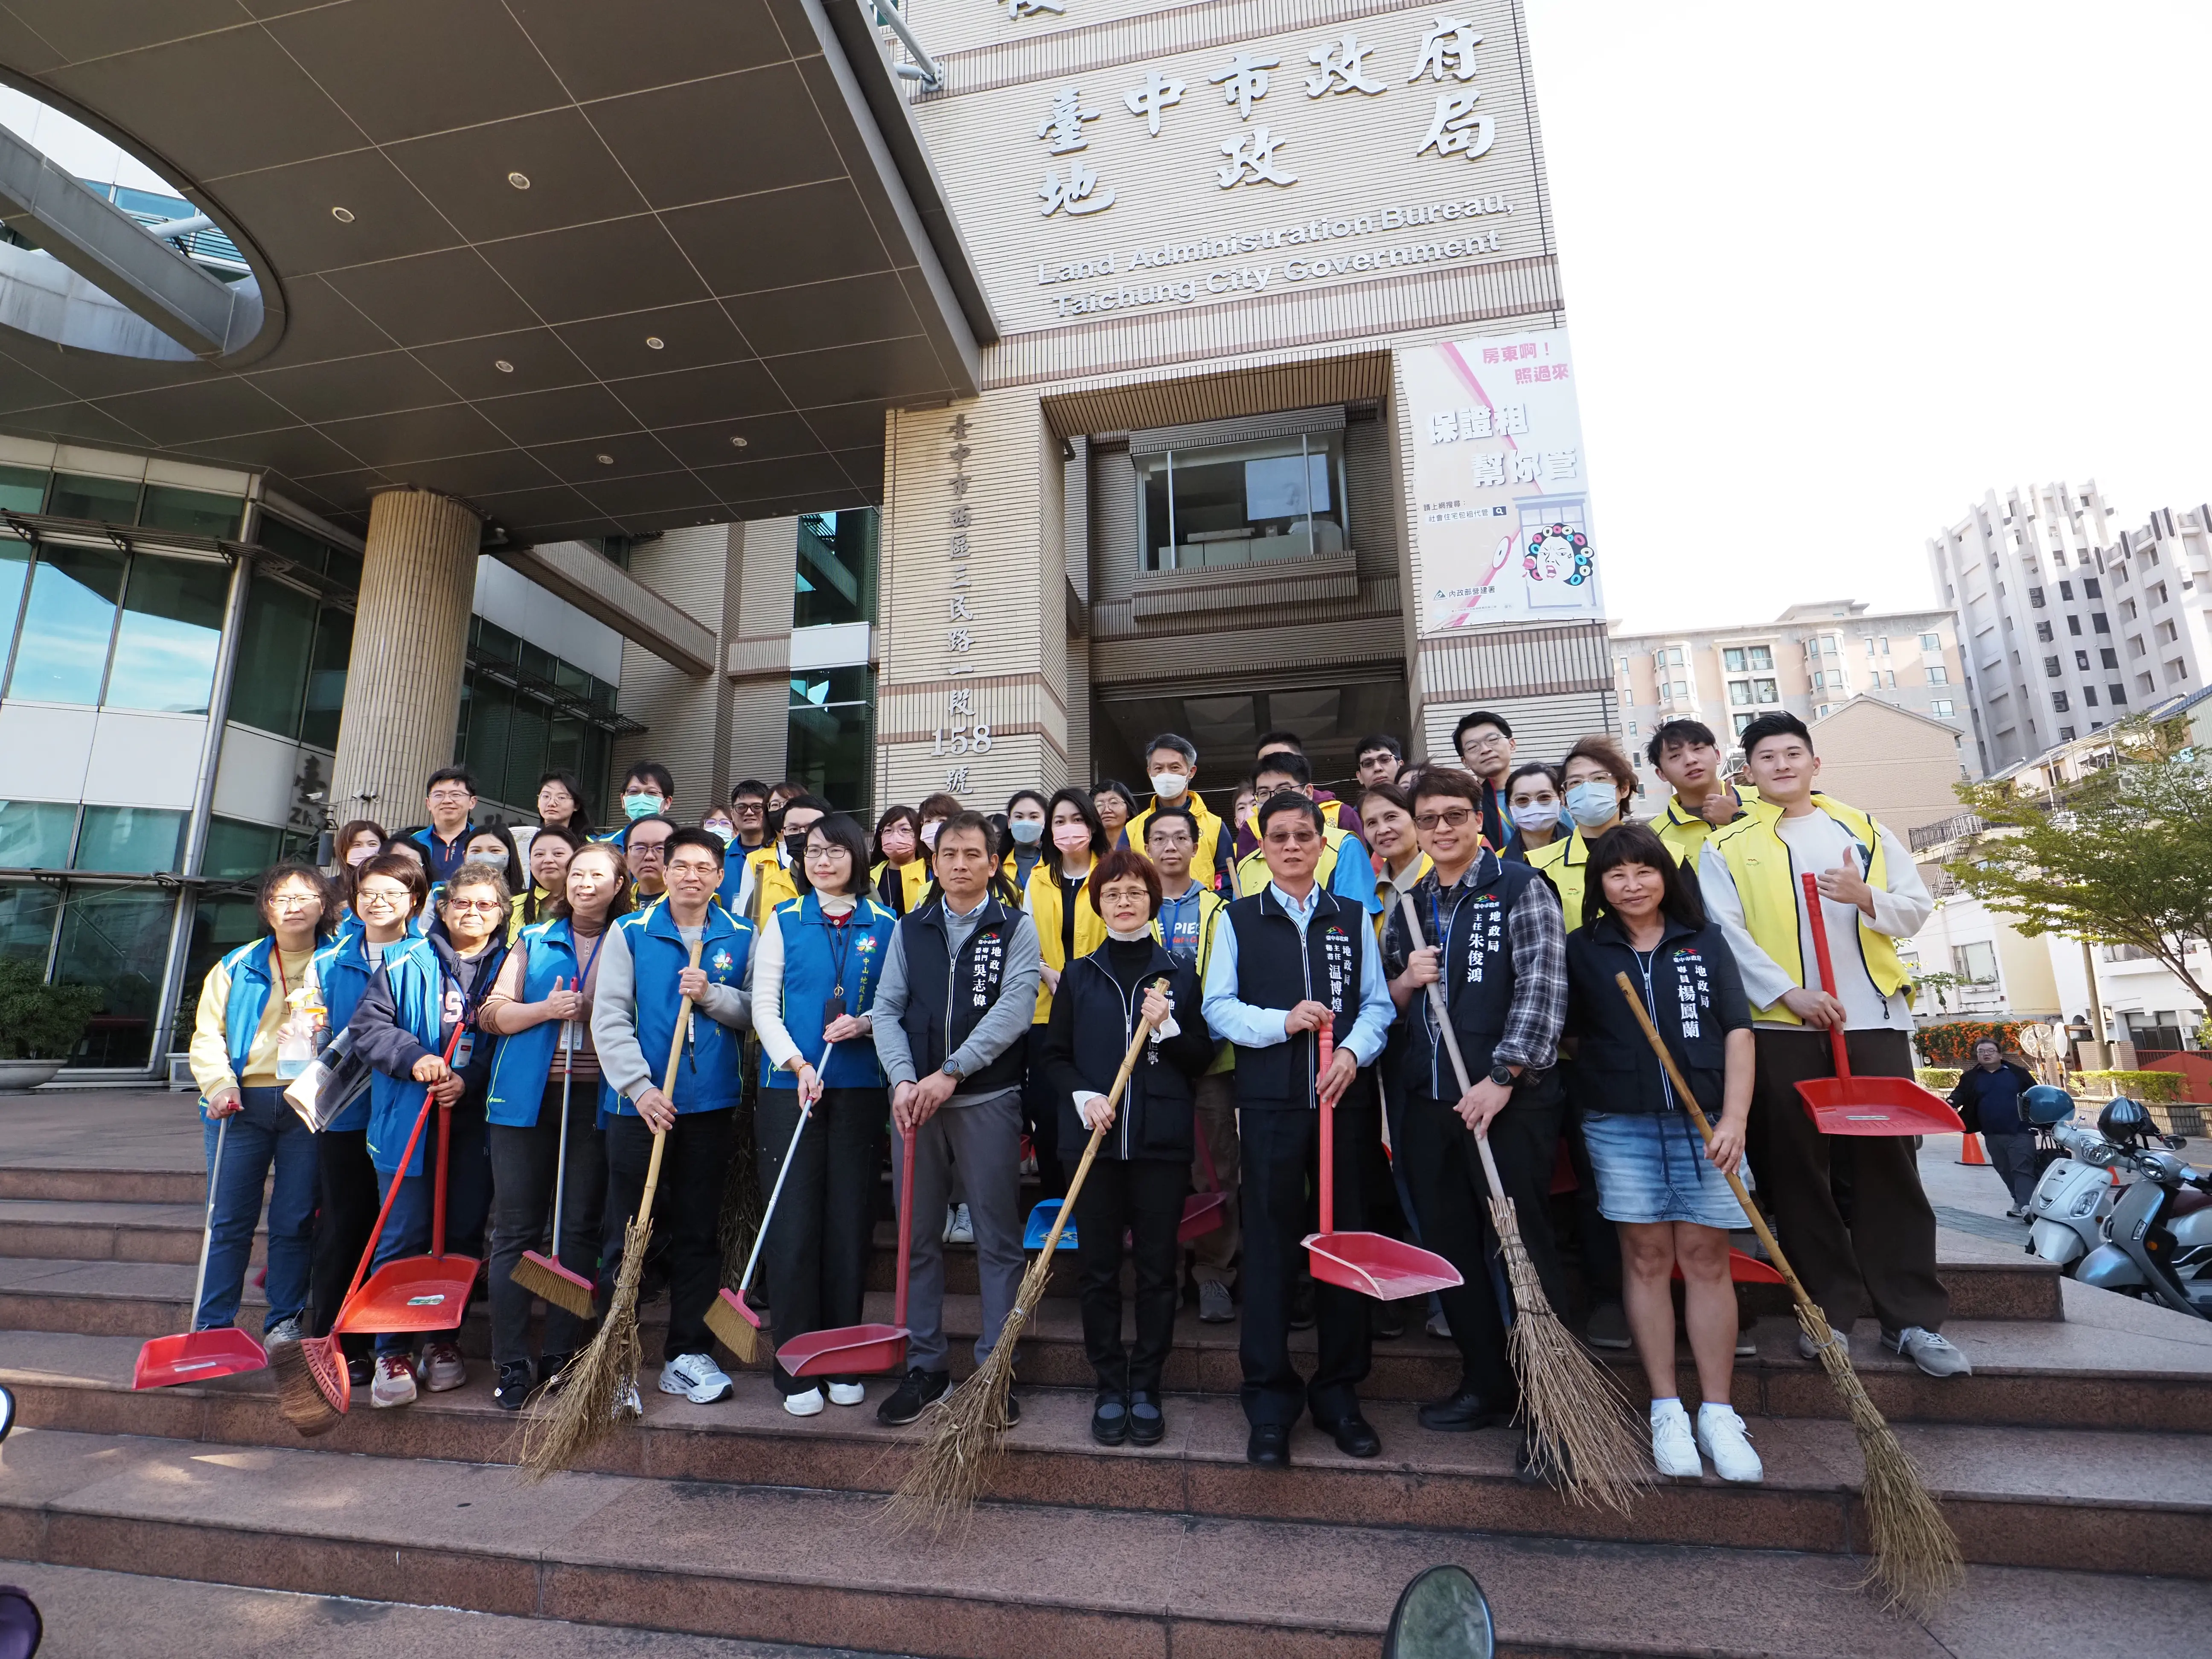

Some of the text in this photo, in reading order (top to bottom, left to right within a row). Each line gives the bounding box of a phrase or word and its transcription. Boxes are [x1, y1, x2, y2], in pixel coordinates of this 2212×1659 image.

[1038, 16, 1483, 156] 臺中市政府
[1039, 90, 1496, 216] 地政局
[1038, 195, 1513, 285] Land Administration Bureau,
[1053, 230, 1501, 317] Taichung City Government
[1515, 364, 1569, 385] 照過來
[1429, 403, 1529, 444] 保證租
[1472, 448, 1577, 487] 幫你管
[1429, 509, 1488, 522] 社會住宅包租代管
[1487, 911, 1502, 952] 地政局
[988, 947, 1001, 984] 地政局
[1342, 946, 1352, 985] 地政局
[1467, 933, 1485, 983] 朱俊鴻
[972, 963, 987, 1007] 吳志偉
[1695, 965, 1709, 1008] 地政局
[1677, 985, 1700, 1038] 楊鳳蘭
